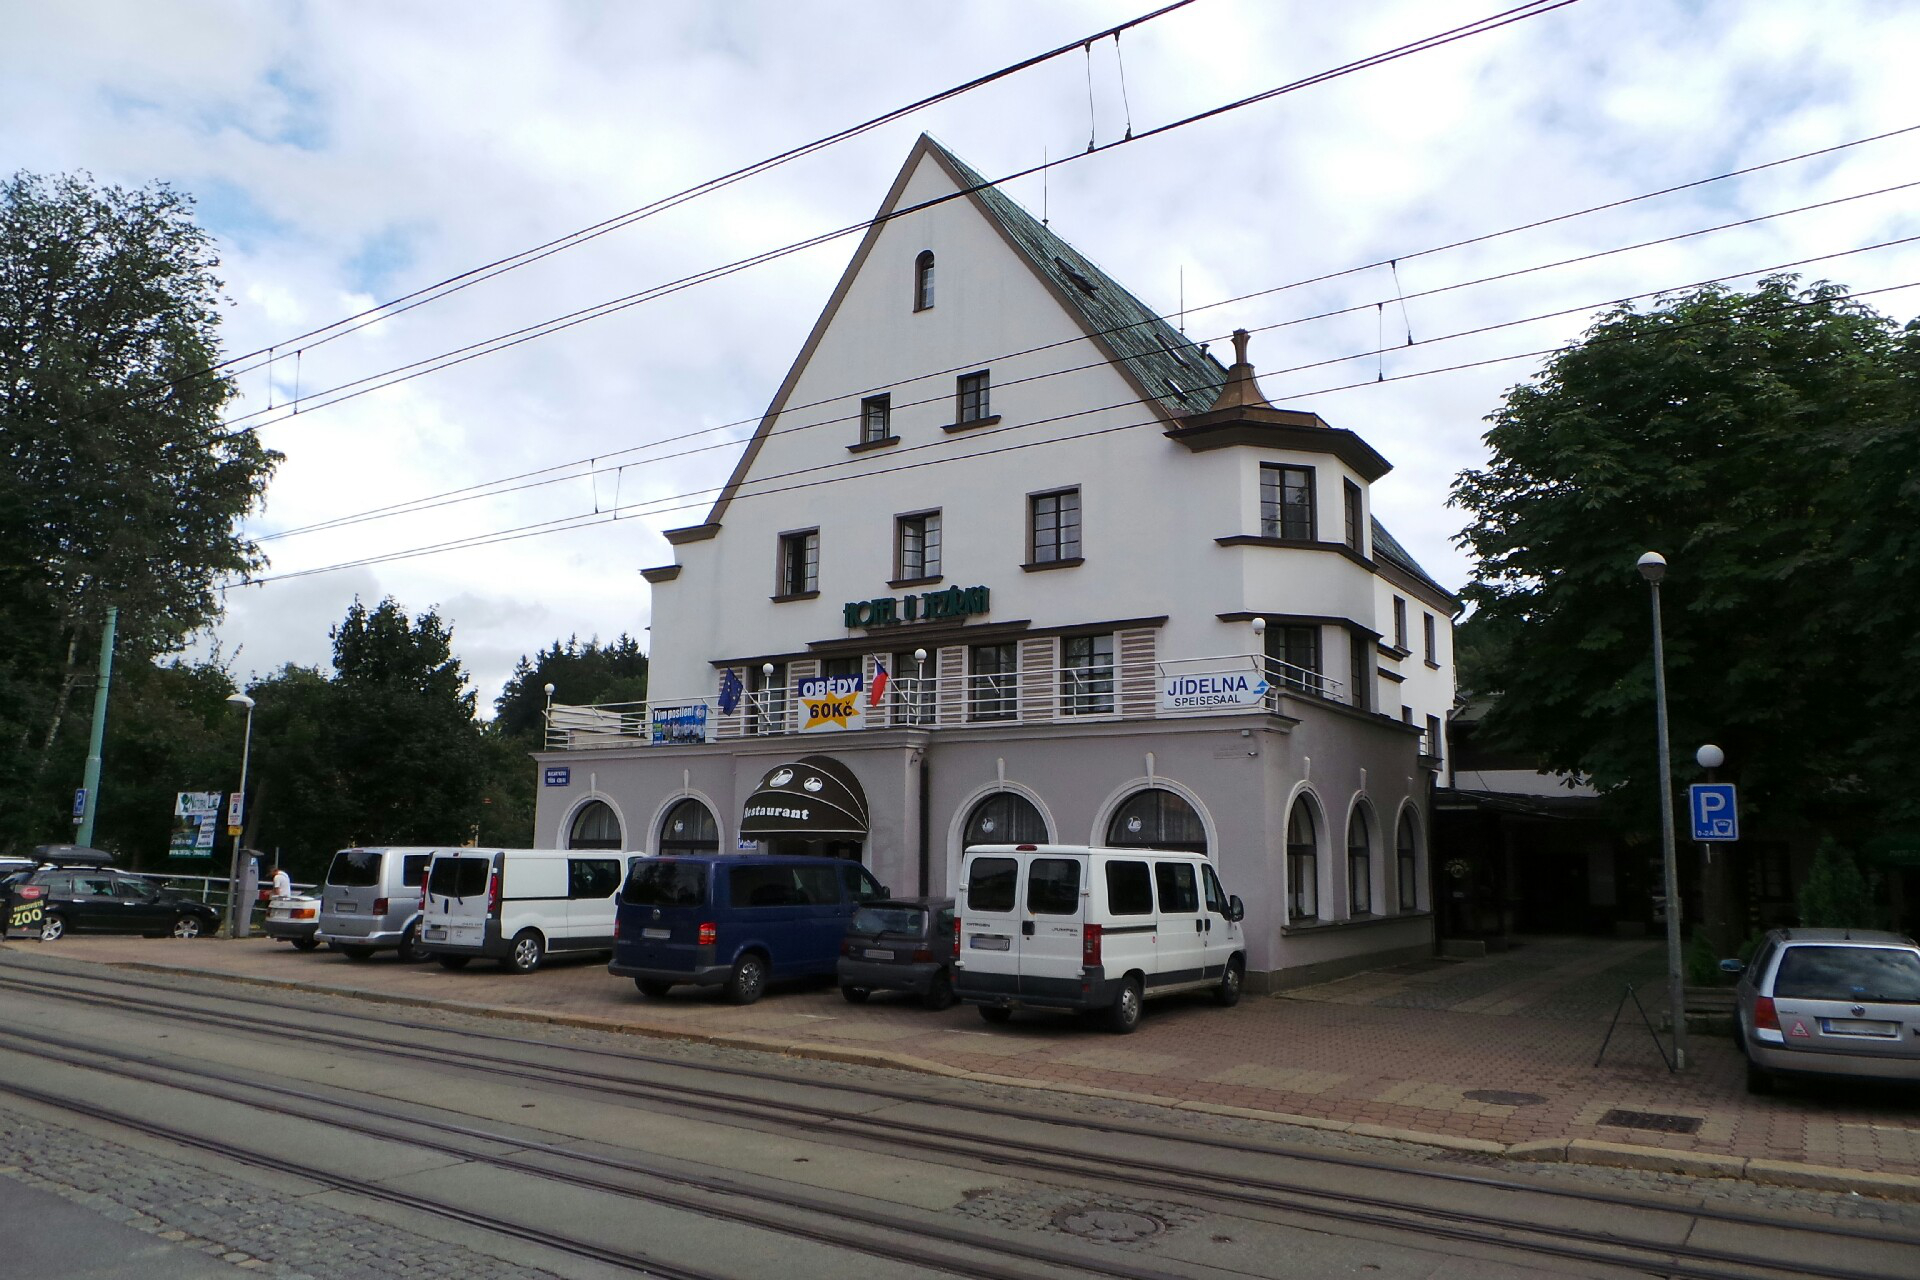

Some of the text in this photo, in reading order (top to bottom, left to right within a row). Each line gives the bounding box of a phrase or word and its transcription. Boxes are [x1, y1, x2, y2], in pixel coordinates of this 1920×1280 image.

[843, 597, 901, 628] HOTEL
[904, 595, 917, 621] U
[802, 676, 859, 698] OBĚDY
[1167, 675, 1249, 696] JÍDELNA
[1174, 694, 1241, 707] SPEISESAAL
[743, 805, 810, 820] Restaurant
[1700, 792, 1726, 824] P
[13, 909, 42, 927] ZOO
